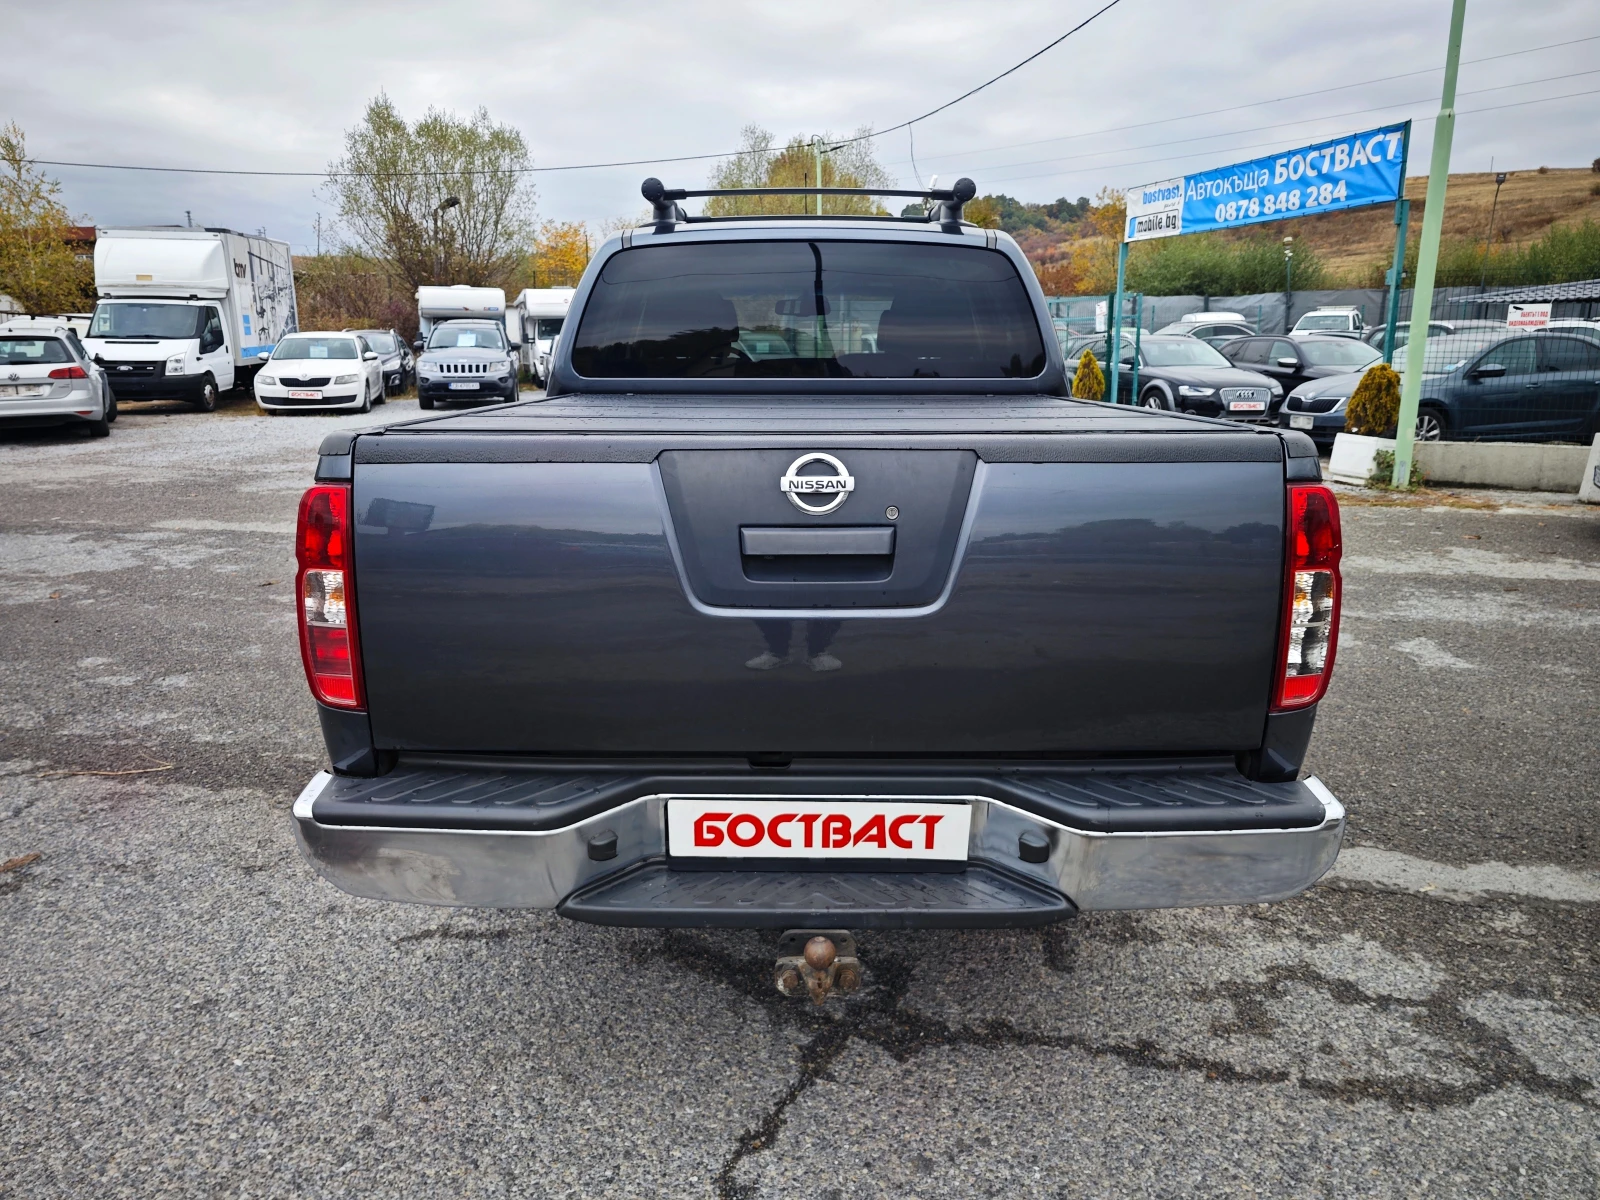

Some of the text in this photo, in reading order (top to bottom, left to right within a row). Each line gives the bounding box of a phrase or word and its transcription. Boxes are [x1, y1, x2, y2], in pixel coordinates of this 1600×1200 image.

[1274, 131, 1403, 185] БОСТВАСТ
[1215, 180, 1348, 223] 0878 848 284
[788, 480, 847, 490] NISSAN
[693, 812, 945, 849] БОСТВАСТ
